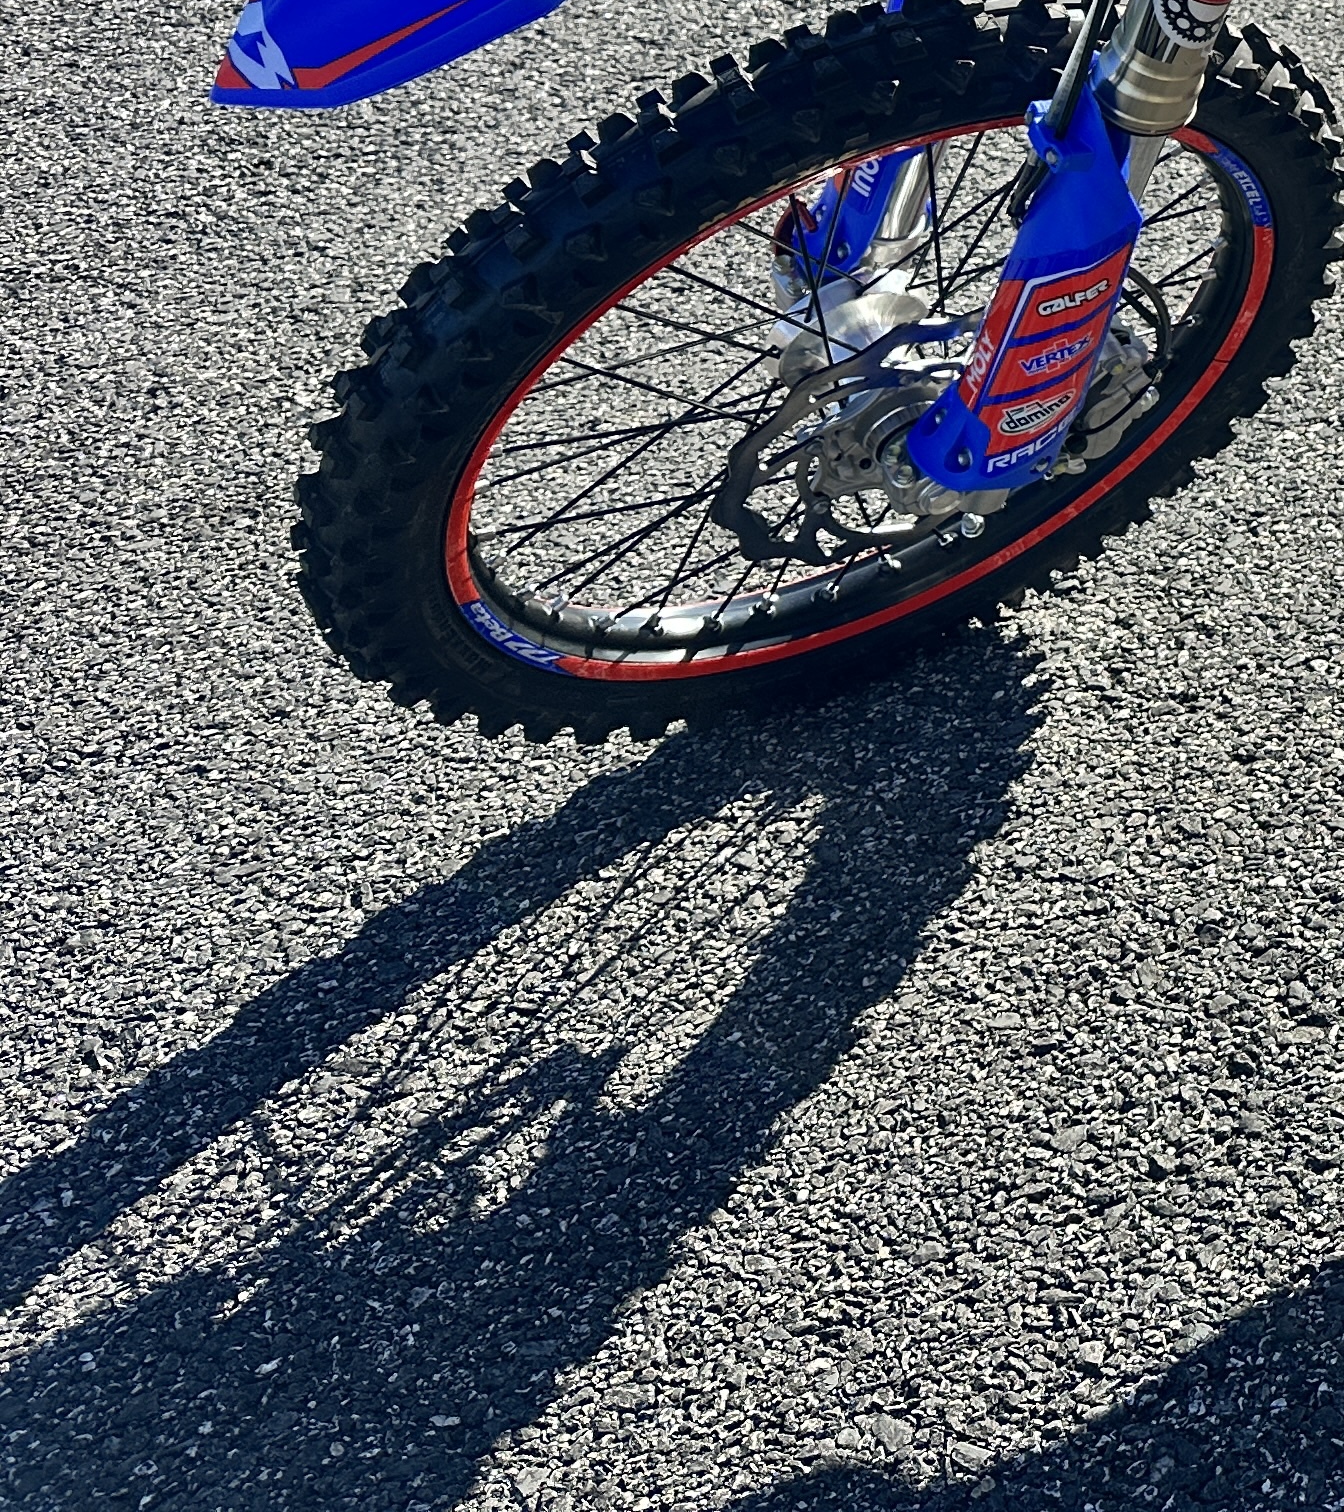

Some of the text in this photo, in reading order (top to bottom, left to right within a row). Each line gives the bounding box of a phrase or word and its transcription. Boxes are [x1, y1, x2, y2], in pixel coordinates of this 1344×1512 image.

[852, 157, 882, 198] QUI
[1234, 170, 1262, 208] EXCEL
[1037, 278, 1111, 317] GALFER
[966, 333, 996, 392] MOLY
[1019, 334, 1094, 373] VERTEX
[1004, 392, 1072, 432] domino
[470, 602, 513, 641] Beta
